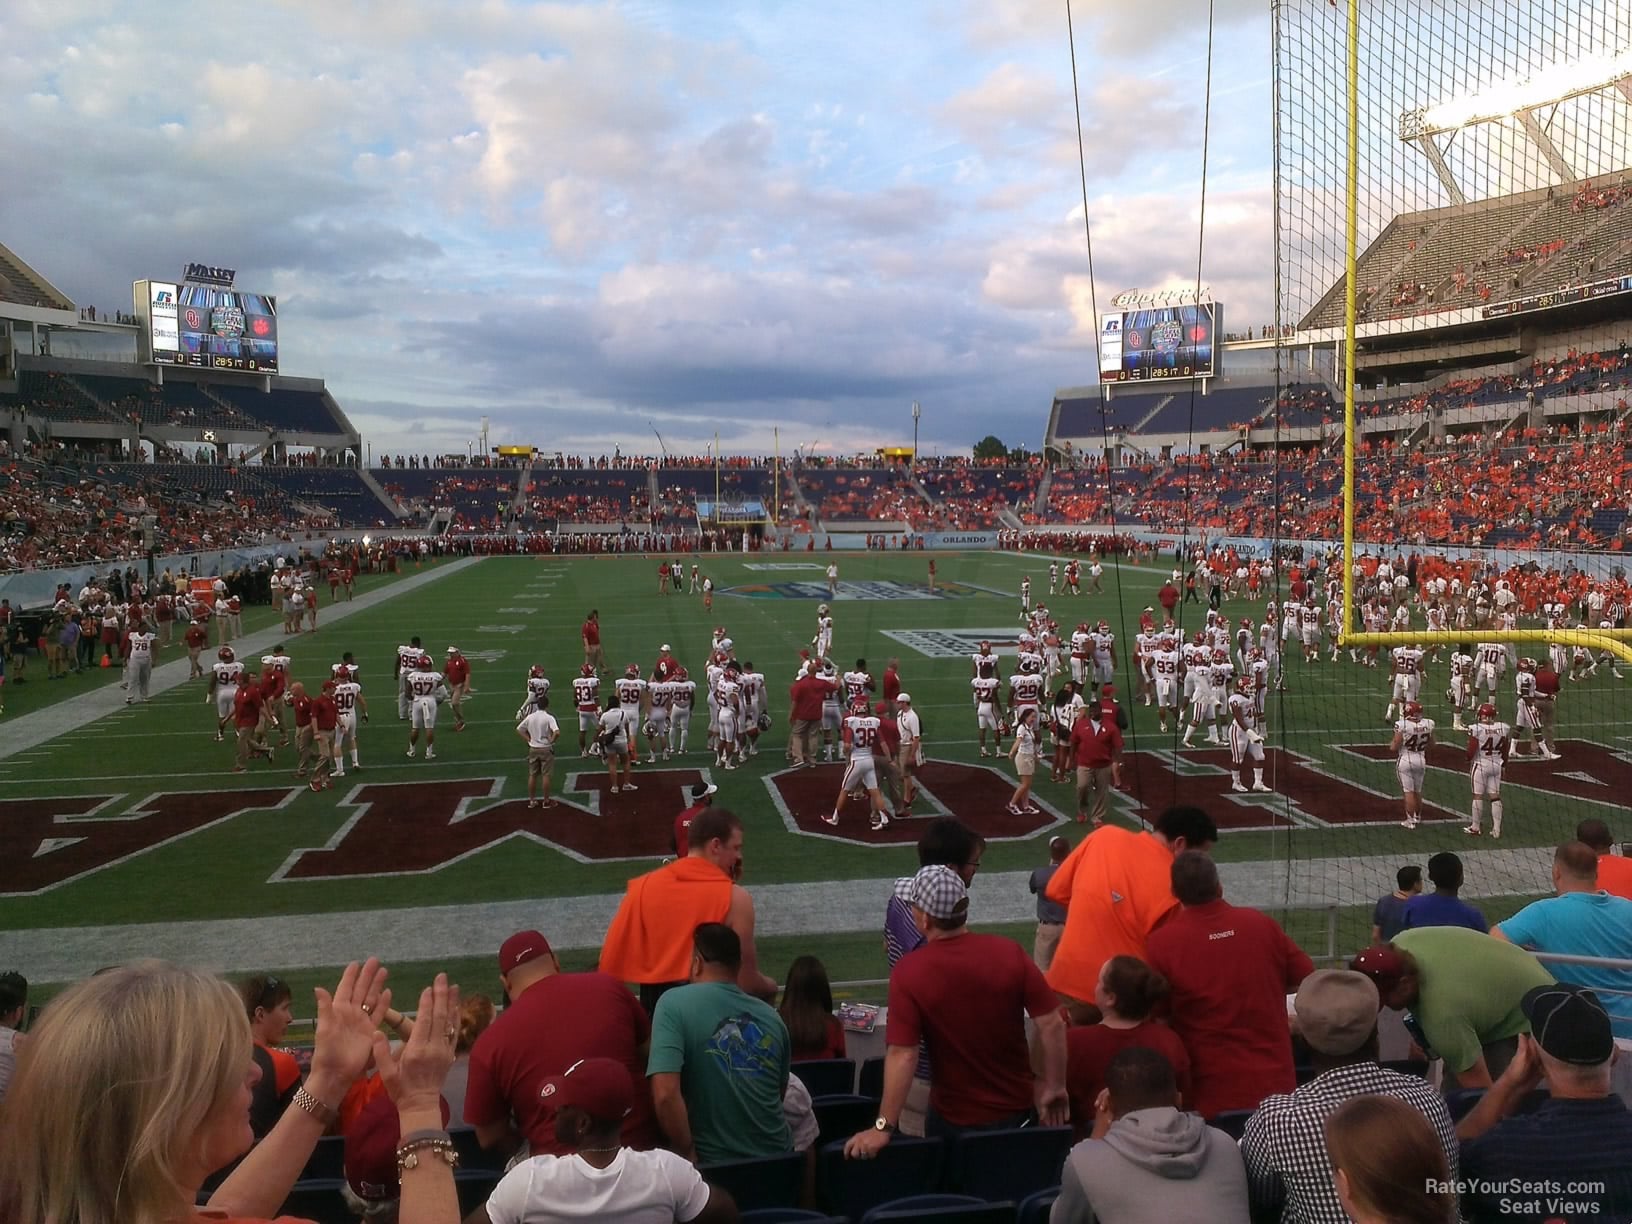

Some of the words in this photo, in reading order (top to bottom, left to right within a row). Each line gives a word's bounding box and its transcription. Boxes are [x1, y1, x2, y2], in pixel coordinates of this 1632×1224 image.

[942, 536, 986, 544] ORLANDO
[1303, 612, 1317, 623] 68
[401, 654, 418, 669] 85
[1485, 649, 1499, 664] 10
[1156, 660, 1175, 674] 93
[1397, 657, 1415, 675] 26
[219, 671, 240, 685] 94
[413, 681, 433, 696] 97
[575, 686, 591, 702] 83
[621, 688, 640, 704] 39
[335, 692, 355, 709] 90
[652, 692, 670, 707] 37
[855, 727, 877, 748] 38
[1404, 733, 1430, 752] 42
[1480, 736, 1507, 755] 44
[1209, 930, 1235, 940] SOONERS
